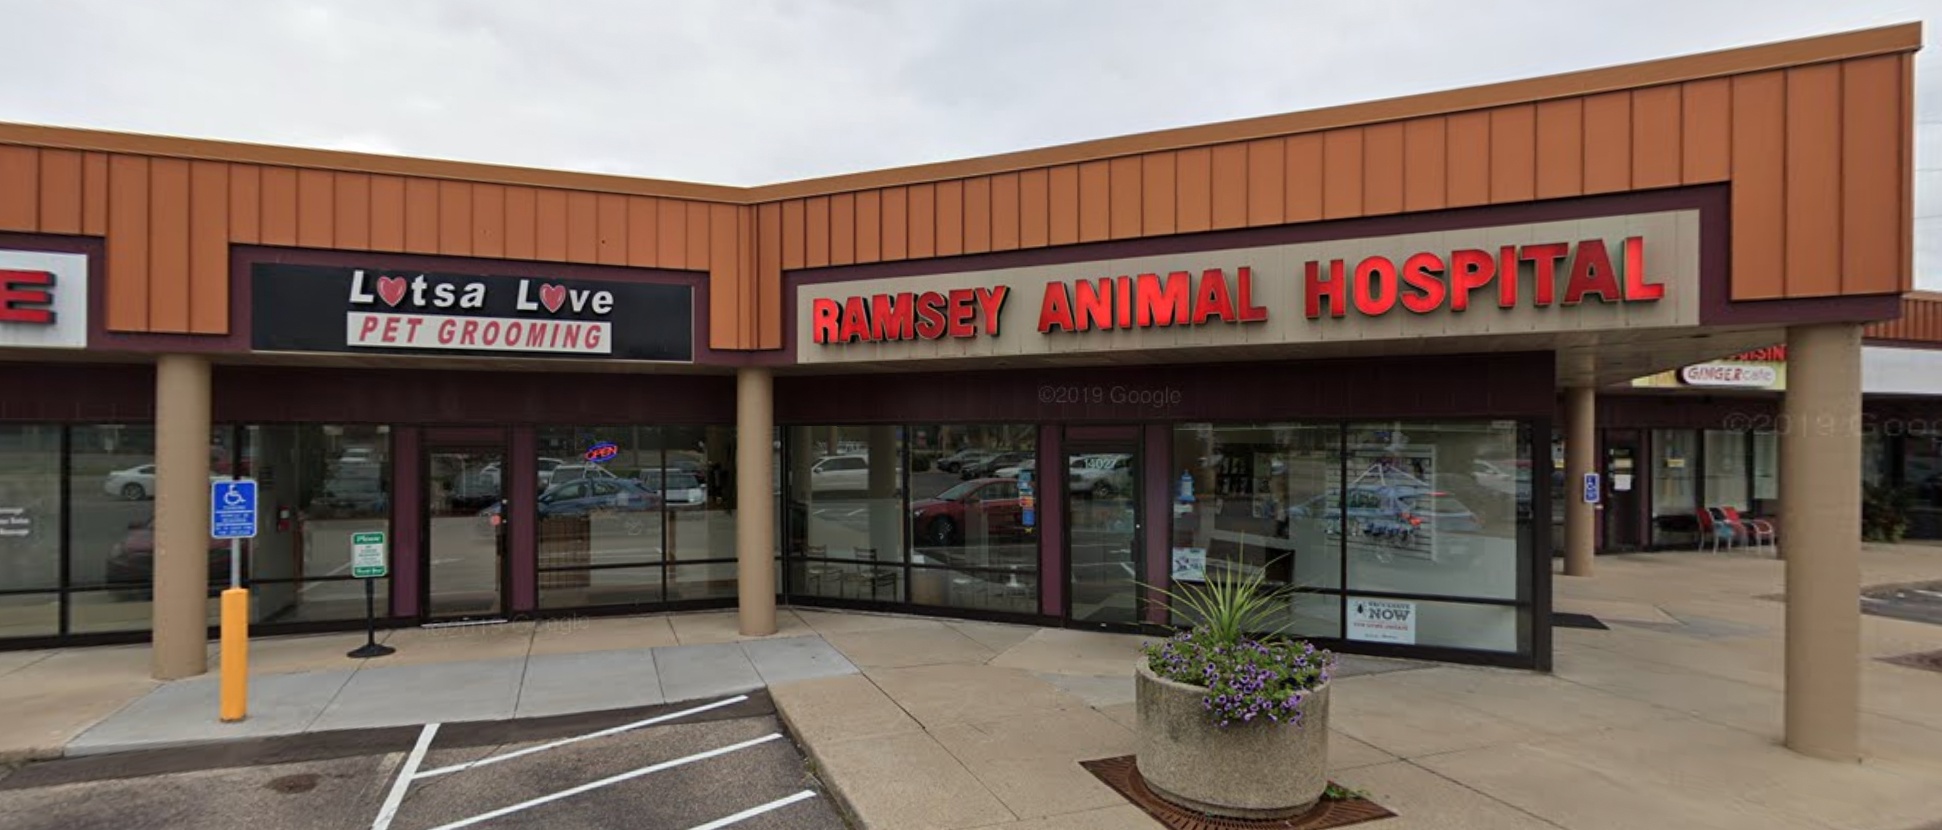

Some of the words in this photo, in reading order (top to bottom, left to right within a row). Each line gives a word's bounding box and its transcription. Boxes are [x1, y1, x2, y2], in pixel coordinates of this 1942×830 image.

[813, 285, 1009, 344] RAMSEY
[1037, 266, 1268, 333] ANIMAL
[1304, 235, 1665, 320] HOSPITAL
[359, 316, 424, 344] PET
[437, 319, 601, 349] GROOMING
[584, 445, 618, 460] OPEN
[1368, 608, 1410, 621] NOW
